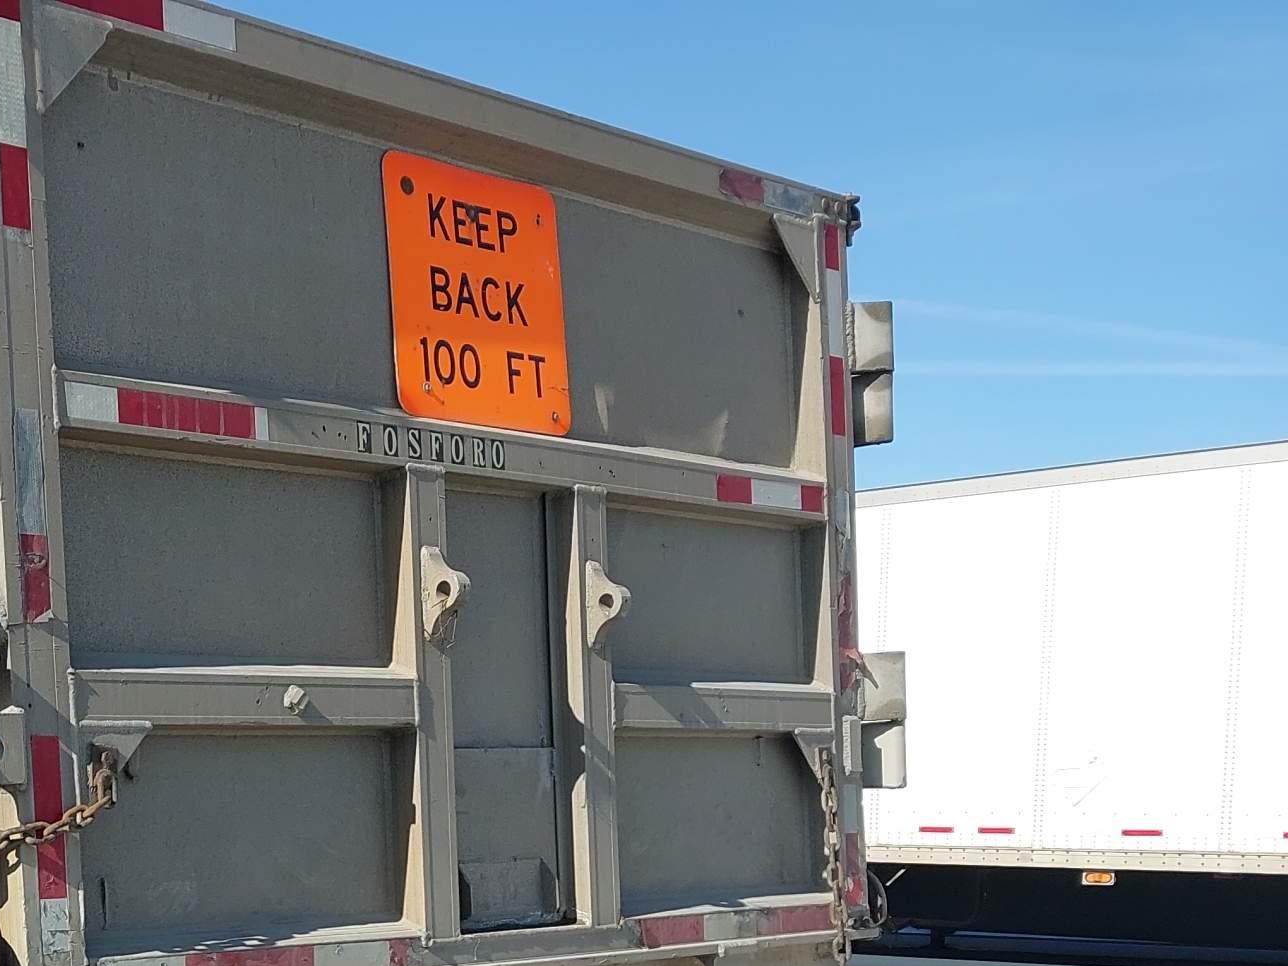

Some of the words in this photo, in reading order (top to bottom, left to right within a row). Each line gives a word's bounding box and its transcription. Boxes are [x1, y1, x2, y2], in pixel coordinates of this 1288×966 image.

[427, 193, 517, 253] KEEP
[430, 265, 528, 327] BACK
[420, 336, 480, 390] 100
[506, 350, 546, 398] FT
[357, 421, 505, 470] FOSFORO
